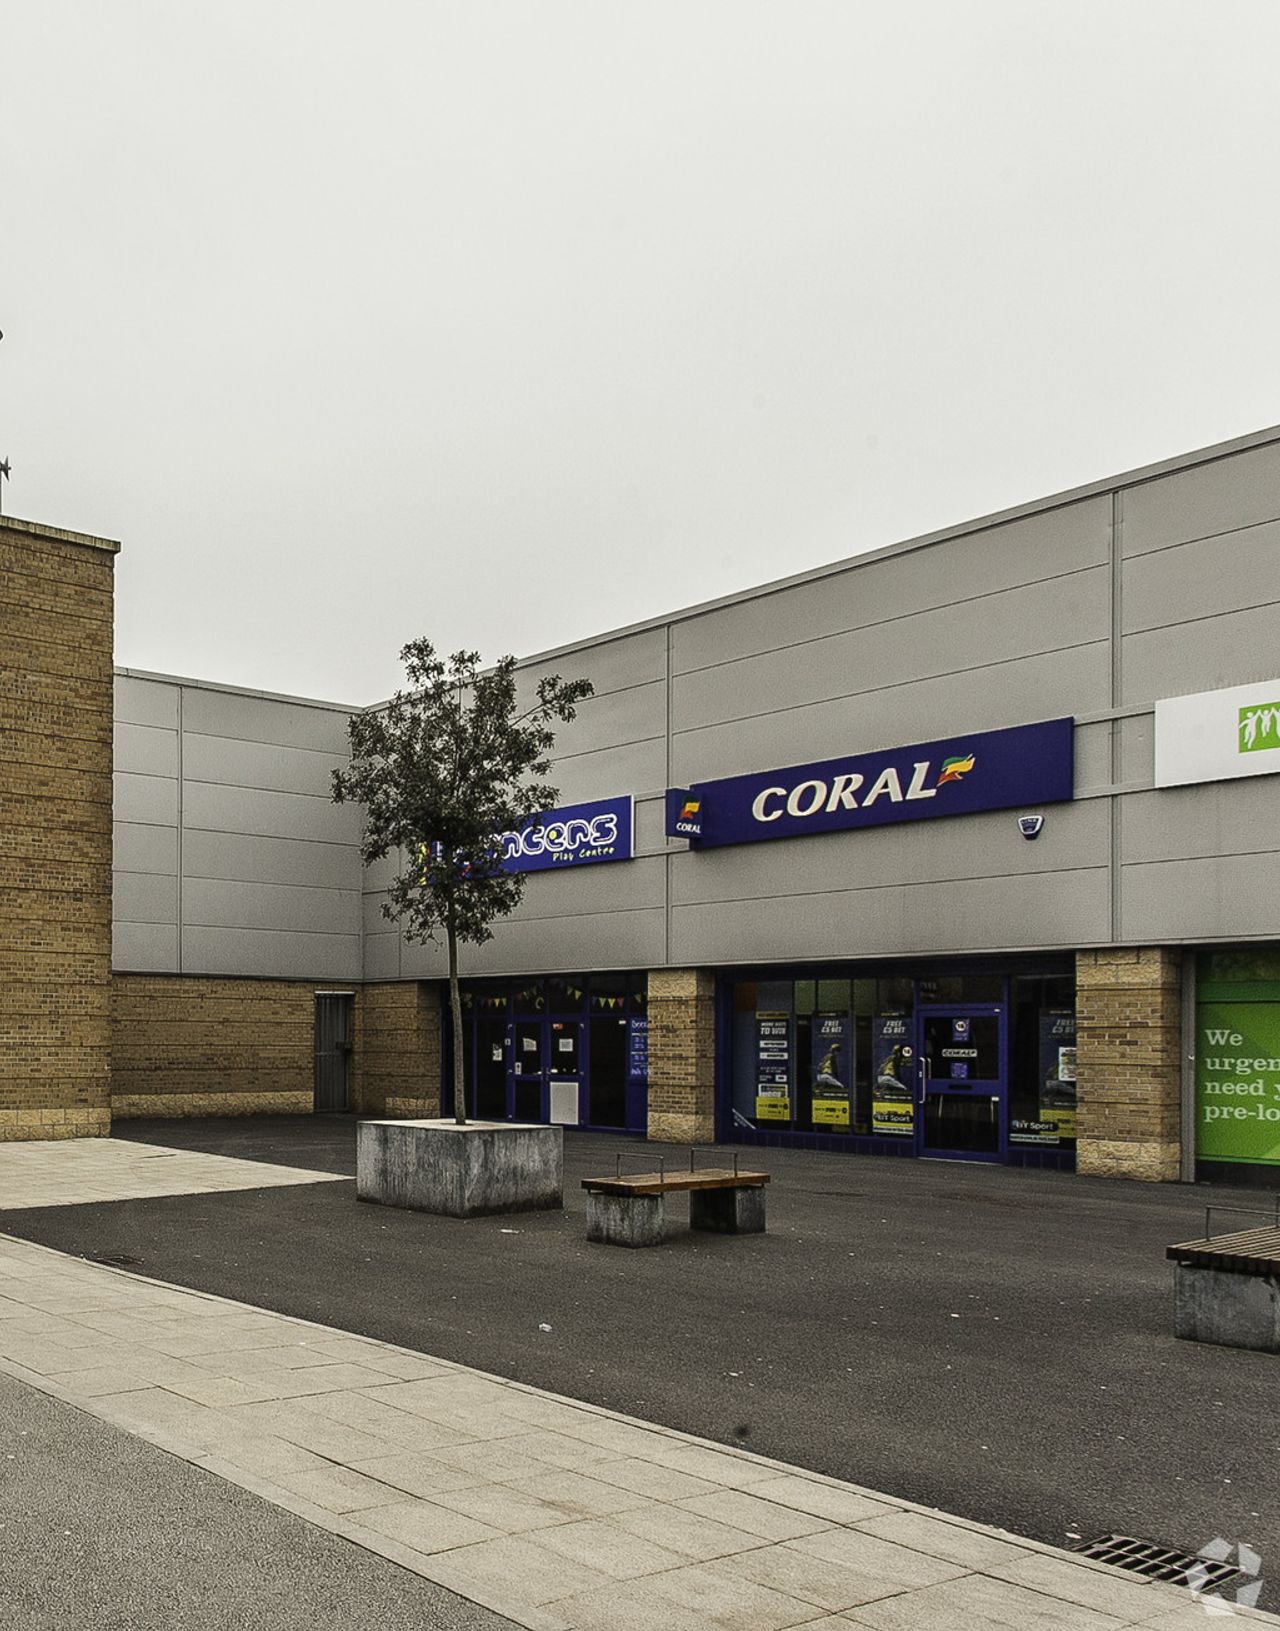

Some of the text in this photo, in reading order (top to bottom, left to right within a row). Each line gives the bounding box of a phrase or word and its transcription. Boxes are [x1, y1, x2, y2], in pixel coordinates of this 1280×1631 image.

[752, 761, 937, 822] CORAL
[676, 821, 702, 834] CORAL
[552, 846, 616, 862] Play Centre
[1204, 1029, 1243, 1046] We
[1204, 1057, 1280, 1075] urgen
[1204, 1078, 1266, 1096] need
[1203, 1103, 1280, 1123] pre-lo
[1030, 1121, 1054, 1130] Sport
